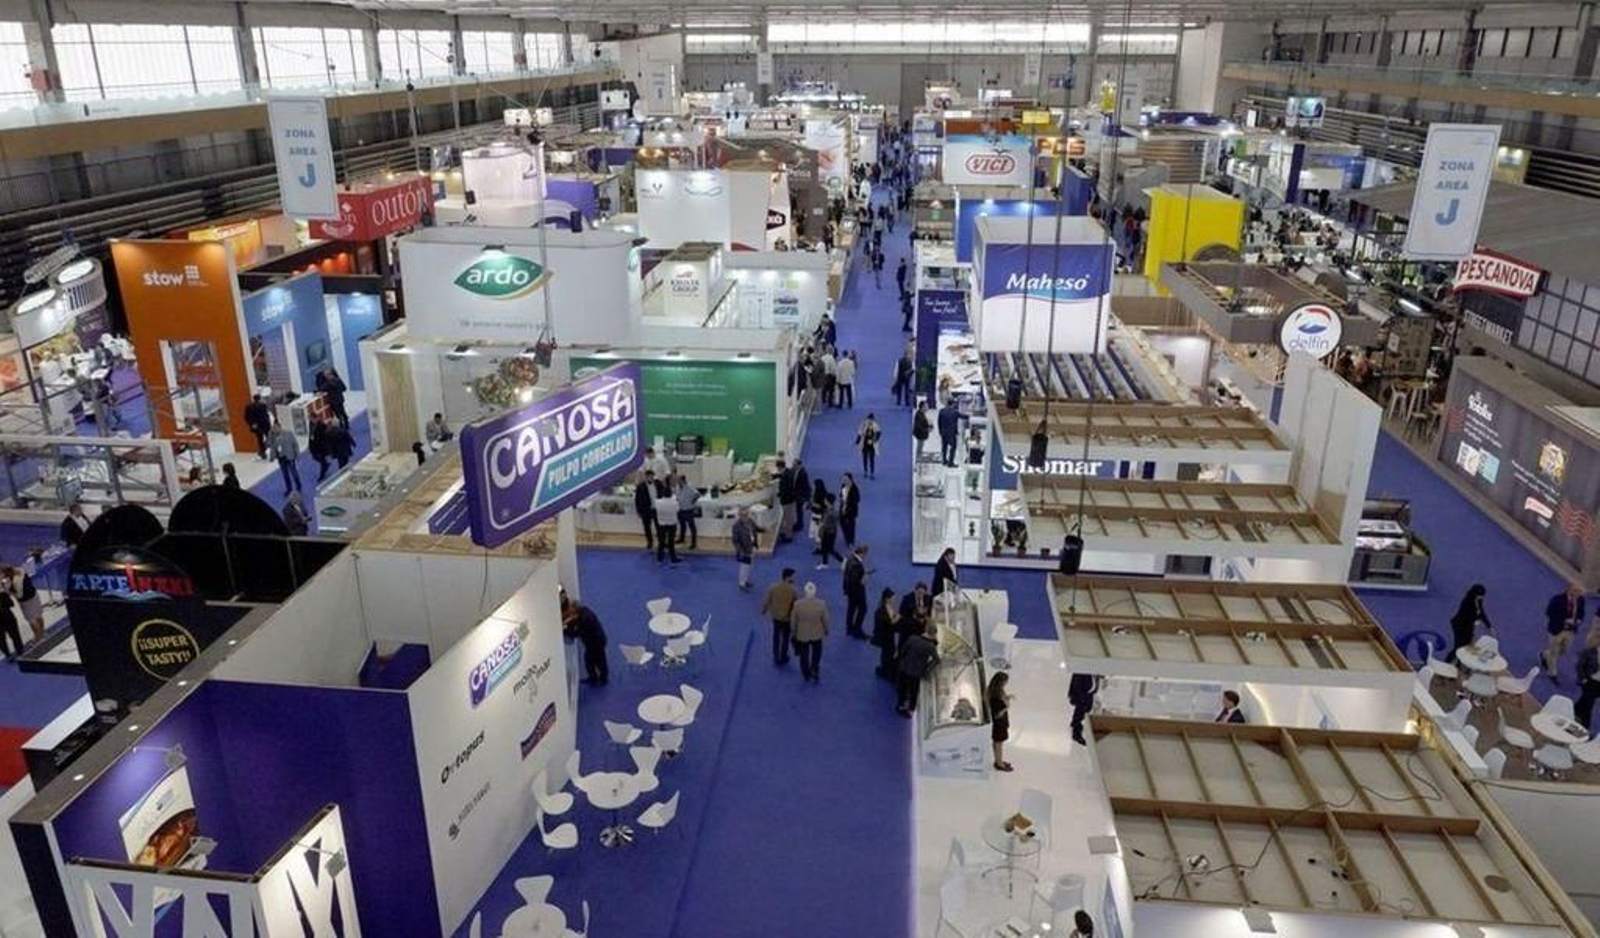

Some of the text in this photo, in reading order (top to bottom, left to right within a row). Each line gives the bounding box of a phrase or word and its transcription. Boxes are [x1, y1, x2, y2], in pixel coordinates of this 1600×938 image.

[285, 128, 316, 139] ZONA
[299, 163, 317, 188] J
[971, 158, 1008, 172] VICI
[1438, 161, 1475, 171] ZONA
[1435, 180, 1469, 190] AREA
[1434, 199, 1460, 226] J
[143, 269, 184, 287] stow
[466, 264, 530, 285] ardo
[1005, 272, 1088, 291] Maheso
[1458, 258, 1536, 292] PESCANOVA
[490, 386, 633, 489] CANOSA
[549, 431, 633, 489] PULPO CONGELADO
[471, 632, 521, 691] CANOSA
